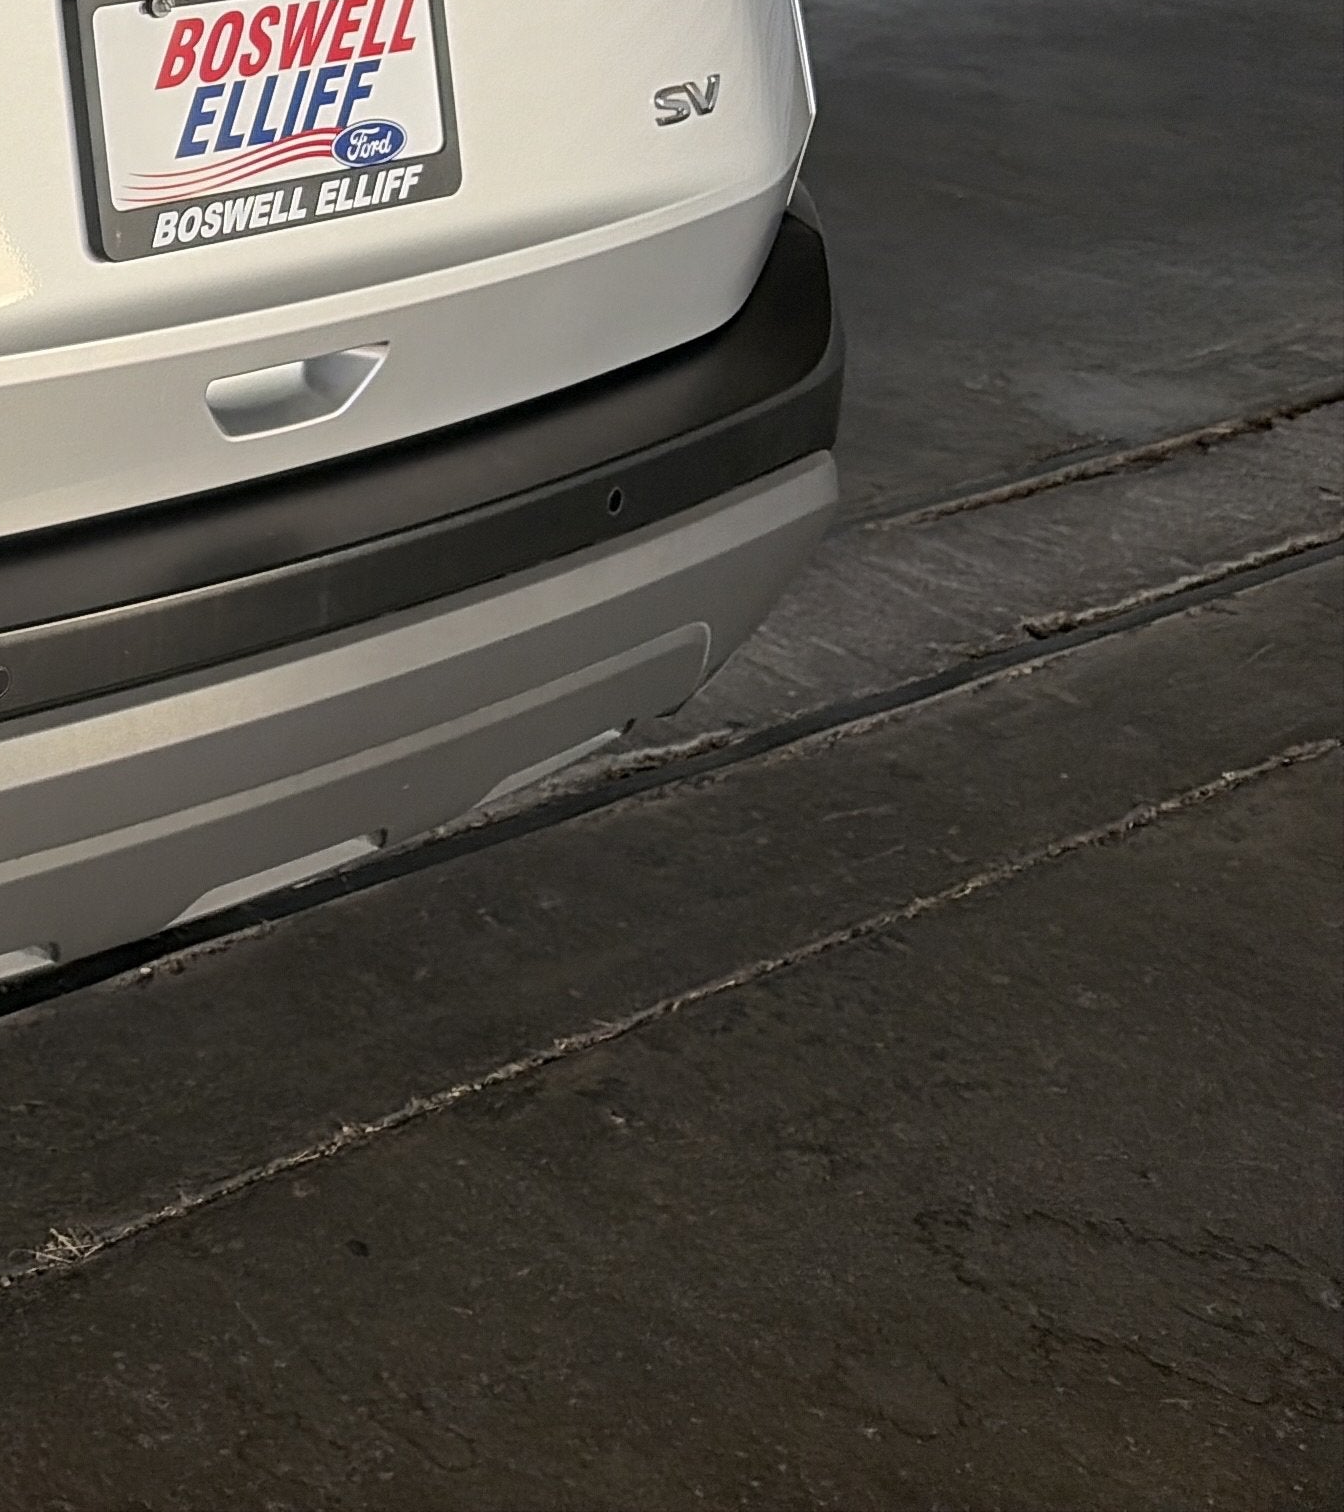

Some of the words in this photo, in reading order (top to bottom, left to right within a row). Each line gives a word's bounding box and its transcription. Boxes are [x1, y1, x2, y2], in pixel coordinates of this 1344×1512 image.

[174, 58, 383, 160] ELLIFF
[653, 74, 721, 126] SV
[346, 126, 392, 163] Ford
[151, 187, 307, 249] BOSWELL
[314, 164, 424, 217] ELLIFF
